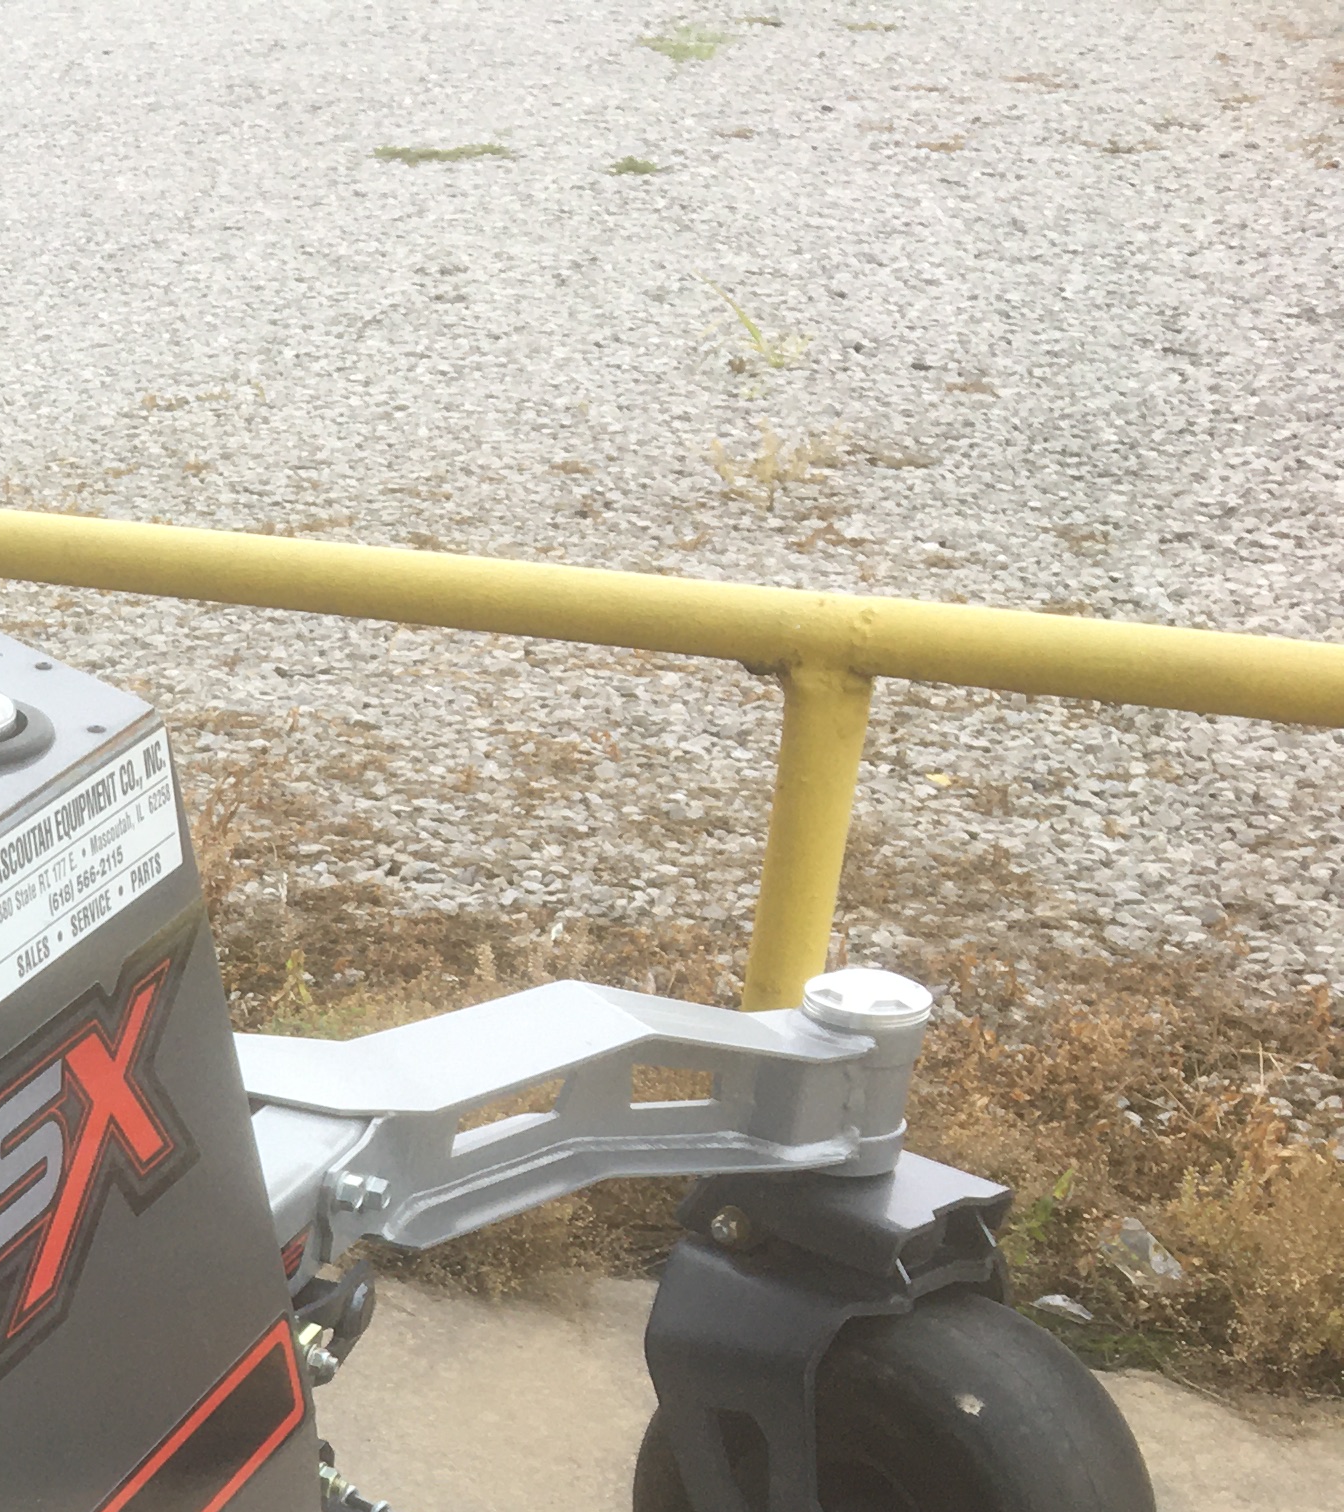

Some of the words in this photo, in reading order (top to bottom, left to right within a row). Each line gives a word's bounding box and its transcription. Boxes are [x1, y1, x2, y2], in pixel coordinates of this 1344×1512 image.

[54, 772, 118, 842] EQUIPMENT
[143, 740, 166, 780] INC.
[14, 882, 37, 911] State
[16, 934, 51, 978] SALES
[70, 889, 113, 938] SERVICE
[130, 852, 161, 892] PARTS
[48, 879, 75, 917] (618)
[76, 845, 124, 894] 566-2115
